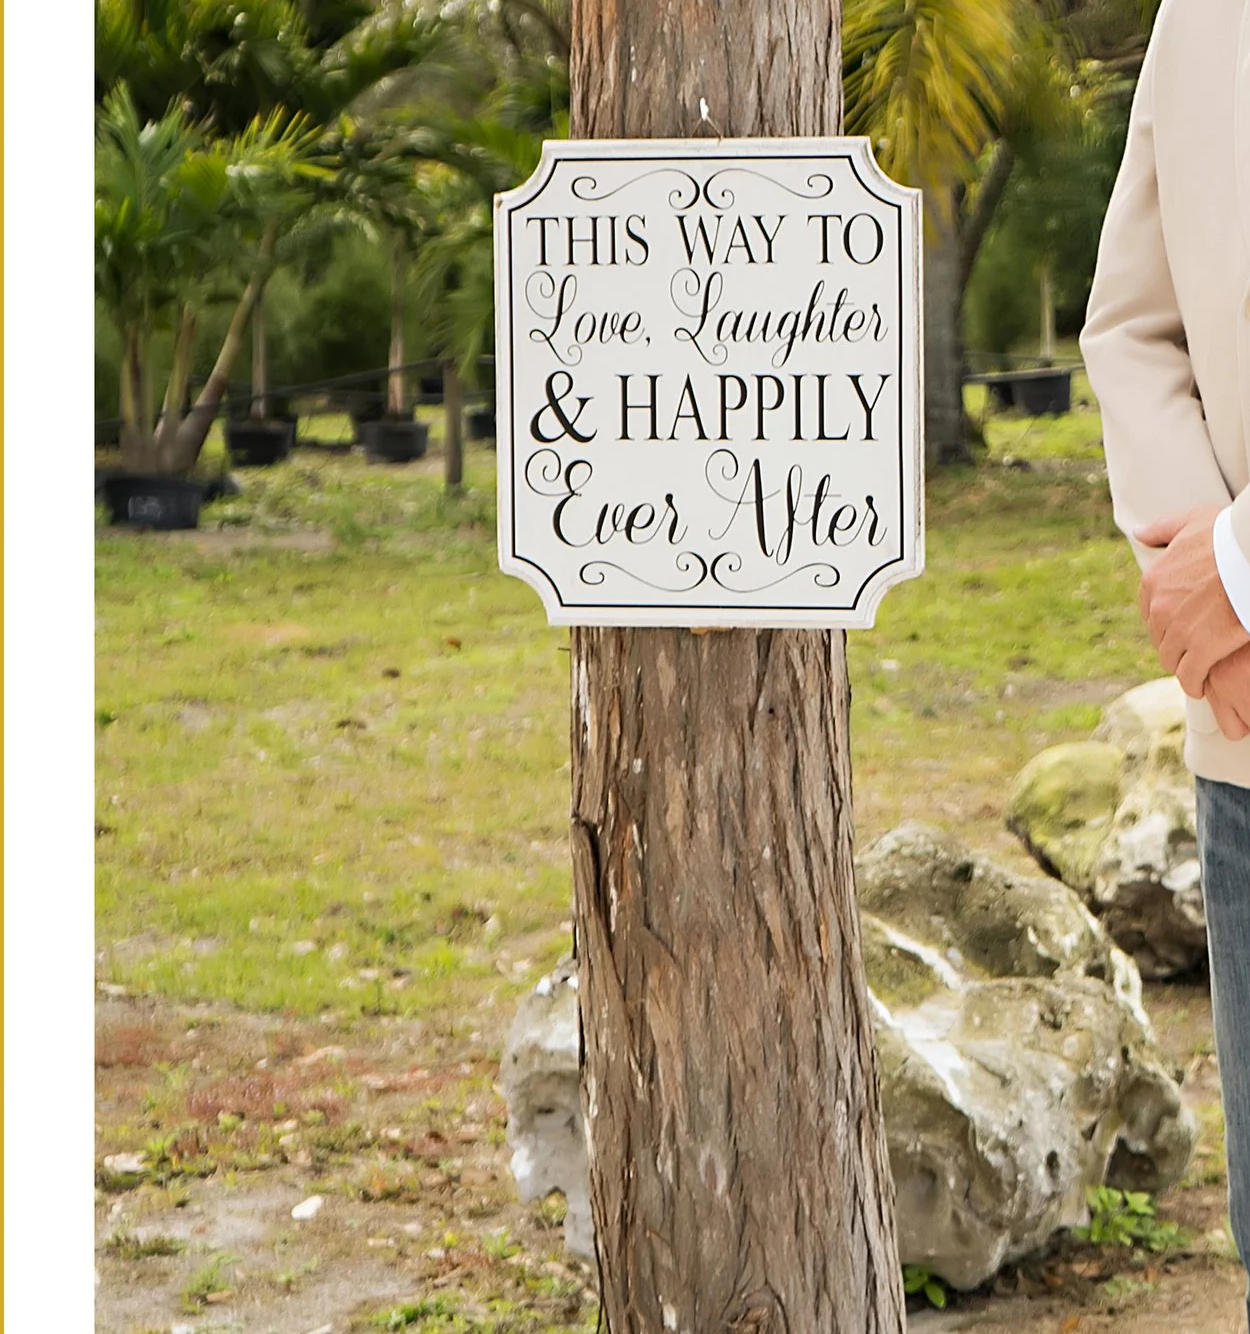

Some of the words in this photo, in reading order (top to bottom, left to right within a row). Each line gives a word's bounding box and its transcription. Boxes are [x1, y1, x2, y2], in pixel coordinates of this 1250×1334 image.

[526, 214, 649, 266] THIS
[675, 214, 788, 265] WAY
[807, 213, 884, 265] TO
[525, 270, 651, 366] Love,
[670, 267, 888, 368] Laughter
[529, 370, 598, 444] &
[614, 373, 892, 442] HAPPILY
[525, 448, 688, 548] Ever
[705, 449, 888, 565] After
